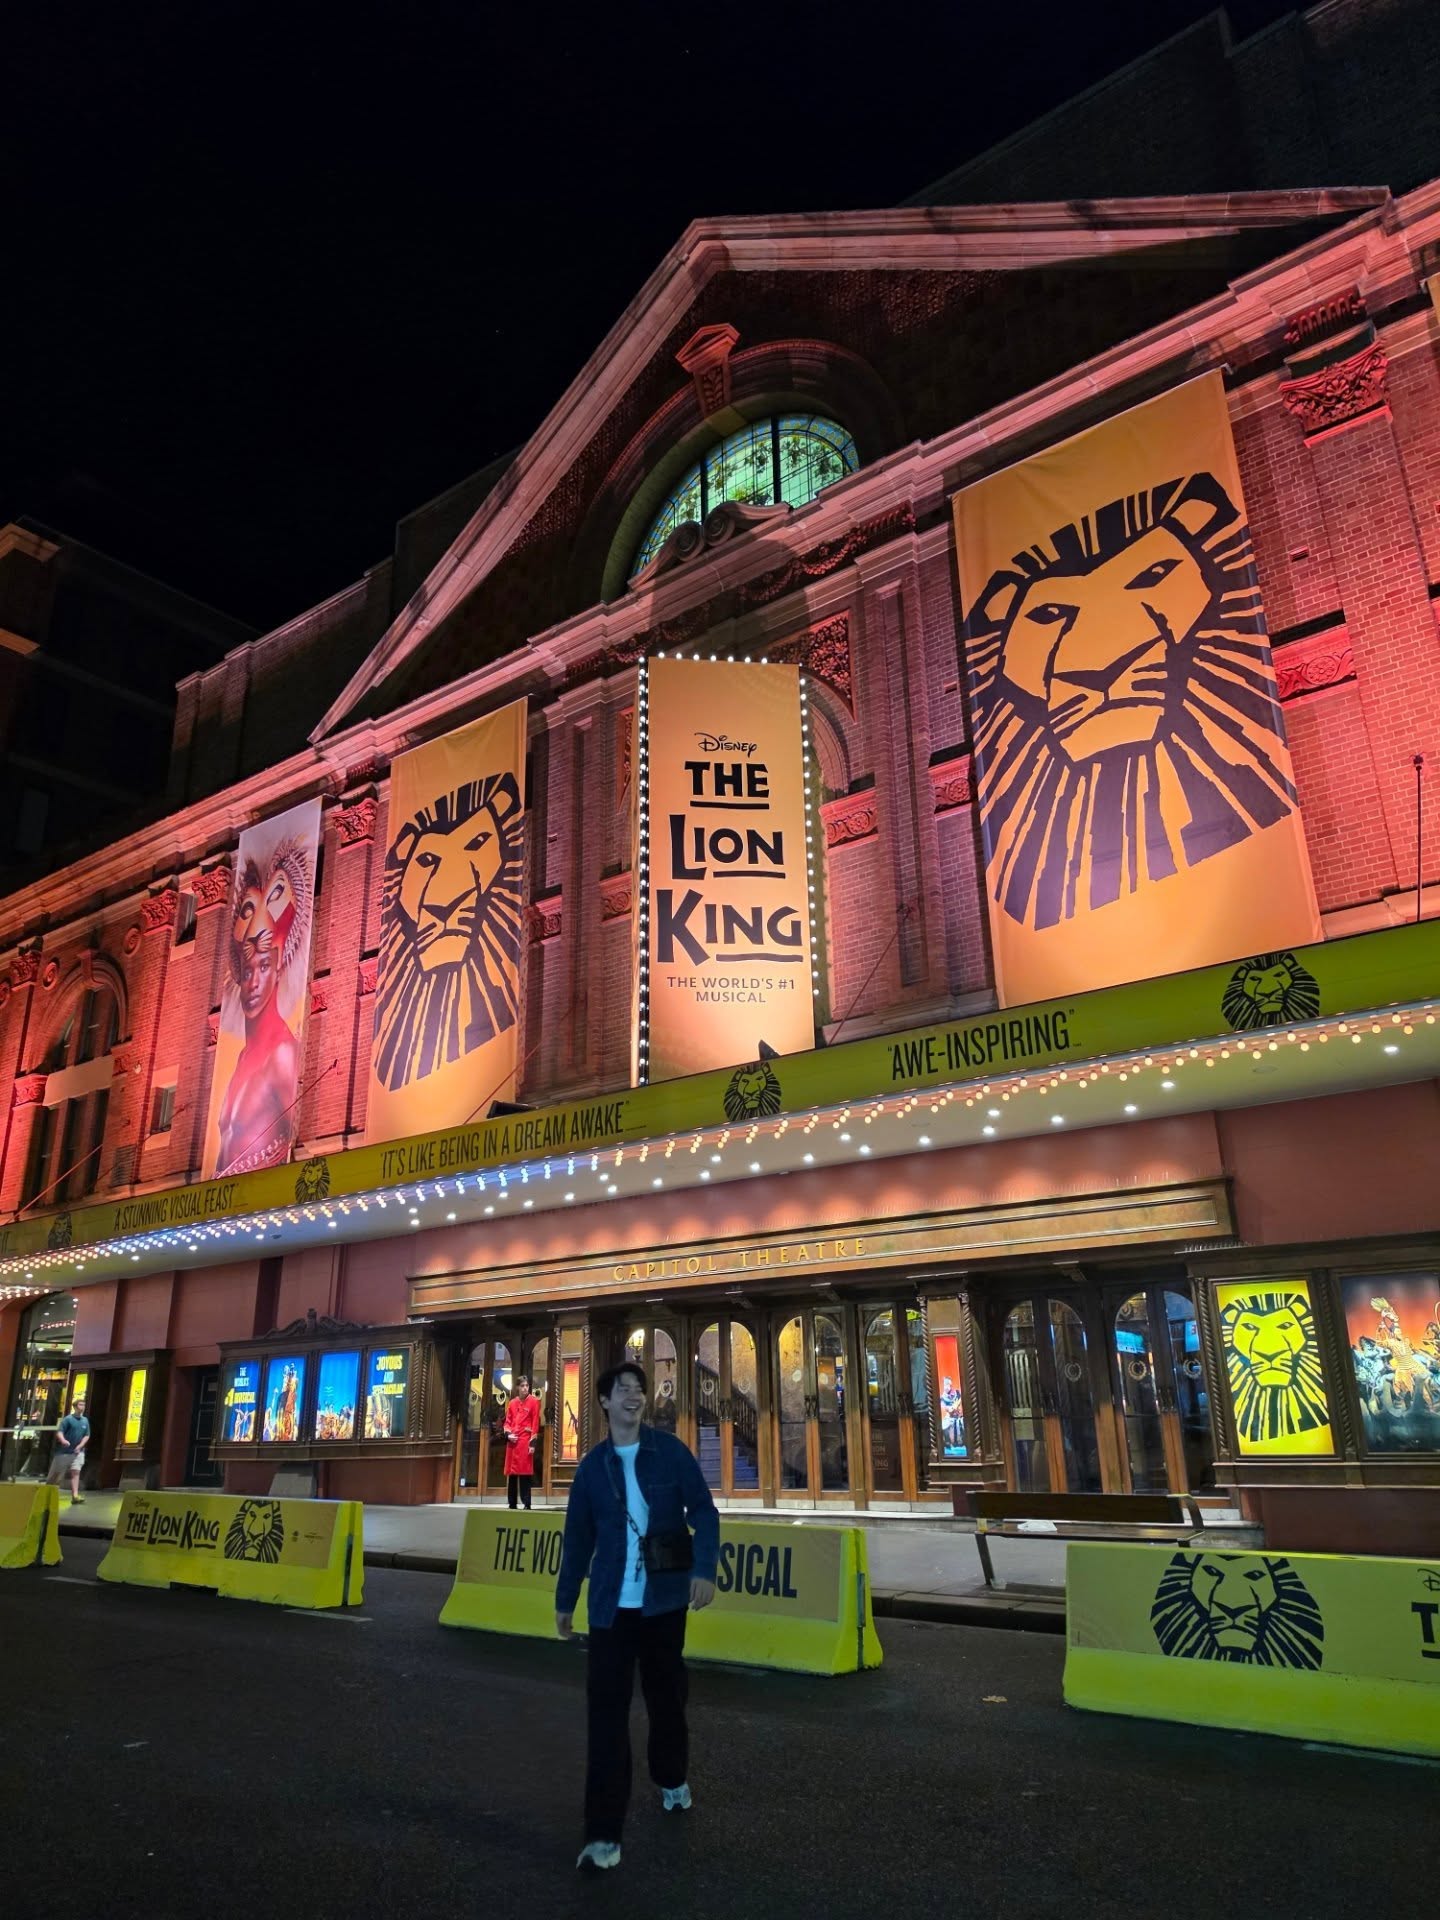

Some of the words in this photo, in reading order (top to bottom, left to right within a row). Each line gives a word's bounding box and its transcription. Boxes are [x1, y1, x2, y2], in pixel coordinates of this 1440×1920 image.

[684, 760, 770, 798] THE
[669, 813, 784, 881] LION
[656, 888, 803, 967] KING
[667, 976, 697, 988] THE
[701, 976, 774, 990] WORLD'S
[778, 978, 795, 990] #1
[695, 990, 767, 1004] MUSICAL
[887, 1008, 1075, 1081] "AWE-INSPIRING"
[408, 1140, 437, 1174] LIKE
[439, 1131, 480, 1168] BEING
[483, 1127, 498, 1159] IN
[500, 1125, 510, 1157] A
[514, 1113, 567, 1153] DREAM
[570, 1100, 630, 1142] AWAKE"
[122, 1197, 169, 1230] STUNNING
[170, 1190, 202, 1220] VISUAL
[613, 1254, 718, 1282] CAPITOL
[739, 1237, 867, 1268] THEATRE
[126, 1512, 149, 1534] THE
[147, 1507, 183, 1545] LION
[179, 1510, 220, 1551] KING
[493, 1527, 530, 1573] THE
[532, 1529, 564, 1576] WO
[716, 1542, 798, 1599] SICAL
